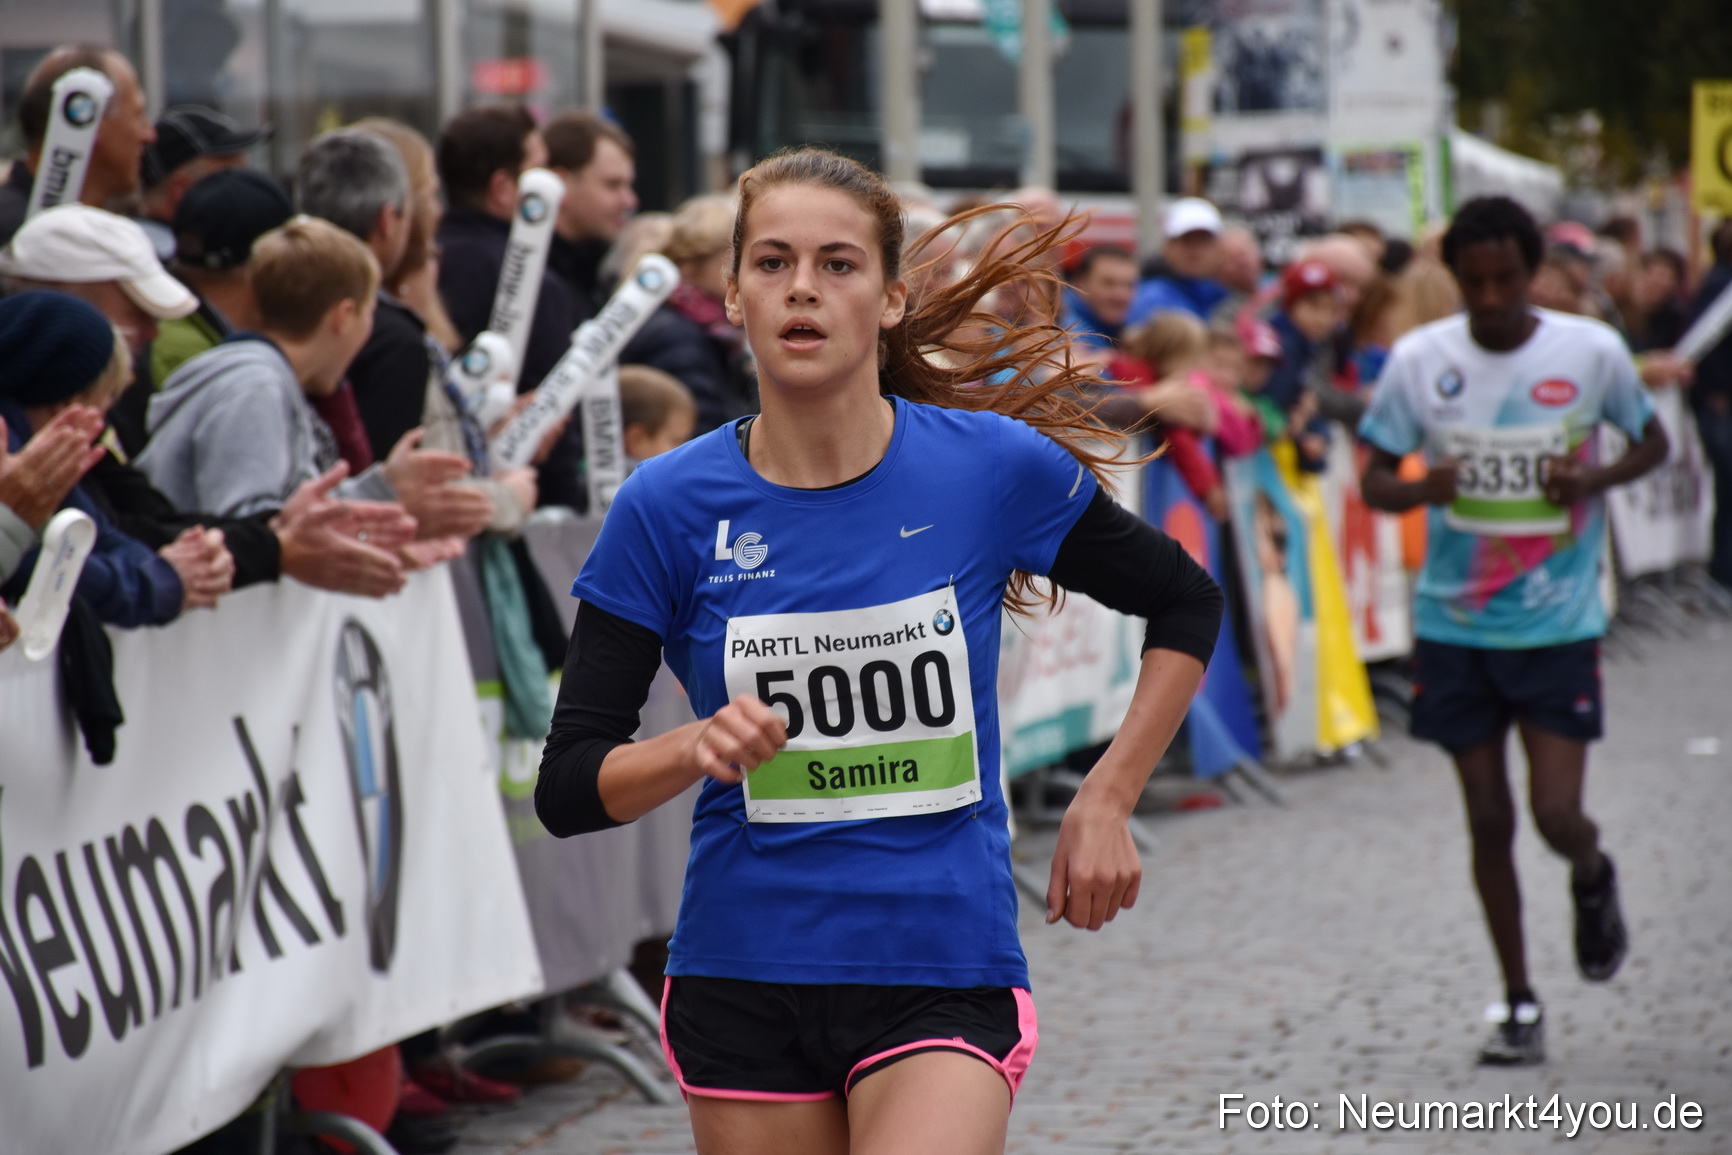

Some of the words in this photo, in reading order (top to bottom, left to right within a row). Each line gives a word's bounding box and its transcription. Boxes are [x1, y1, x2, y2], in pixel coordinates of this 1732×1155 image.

[715, 520, 768, 570] LG
[709, 574, 734, 584] TELIS
[738, 569, 776, 581] FINANZ
[731, 636, 809, 658] PARTL
[815, 621, 927, 654] Neumarkt
[756, 650, 956, 740] 5000
[808, 755, 919, 790] Samira
